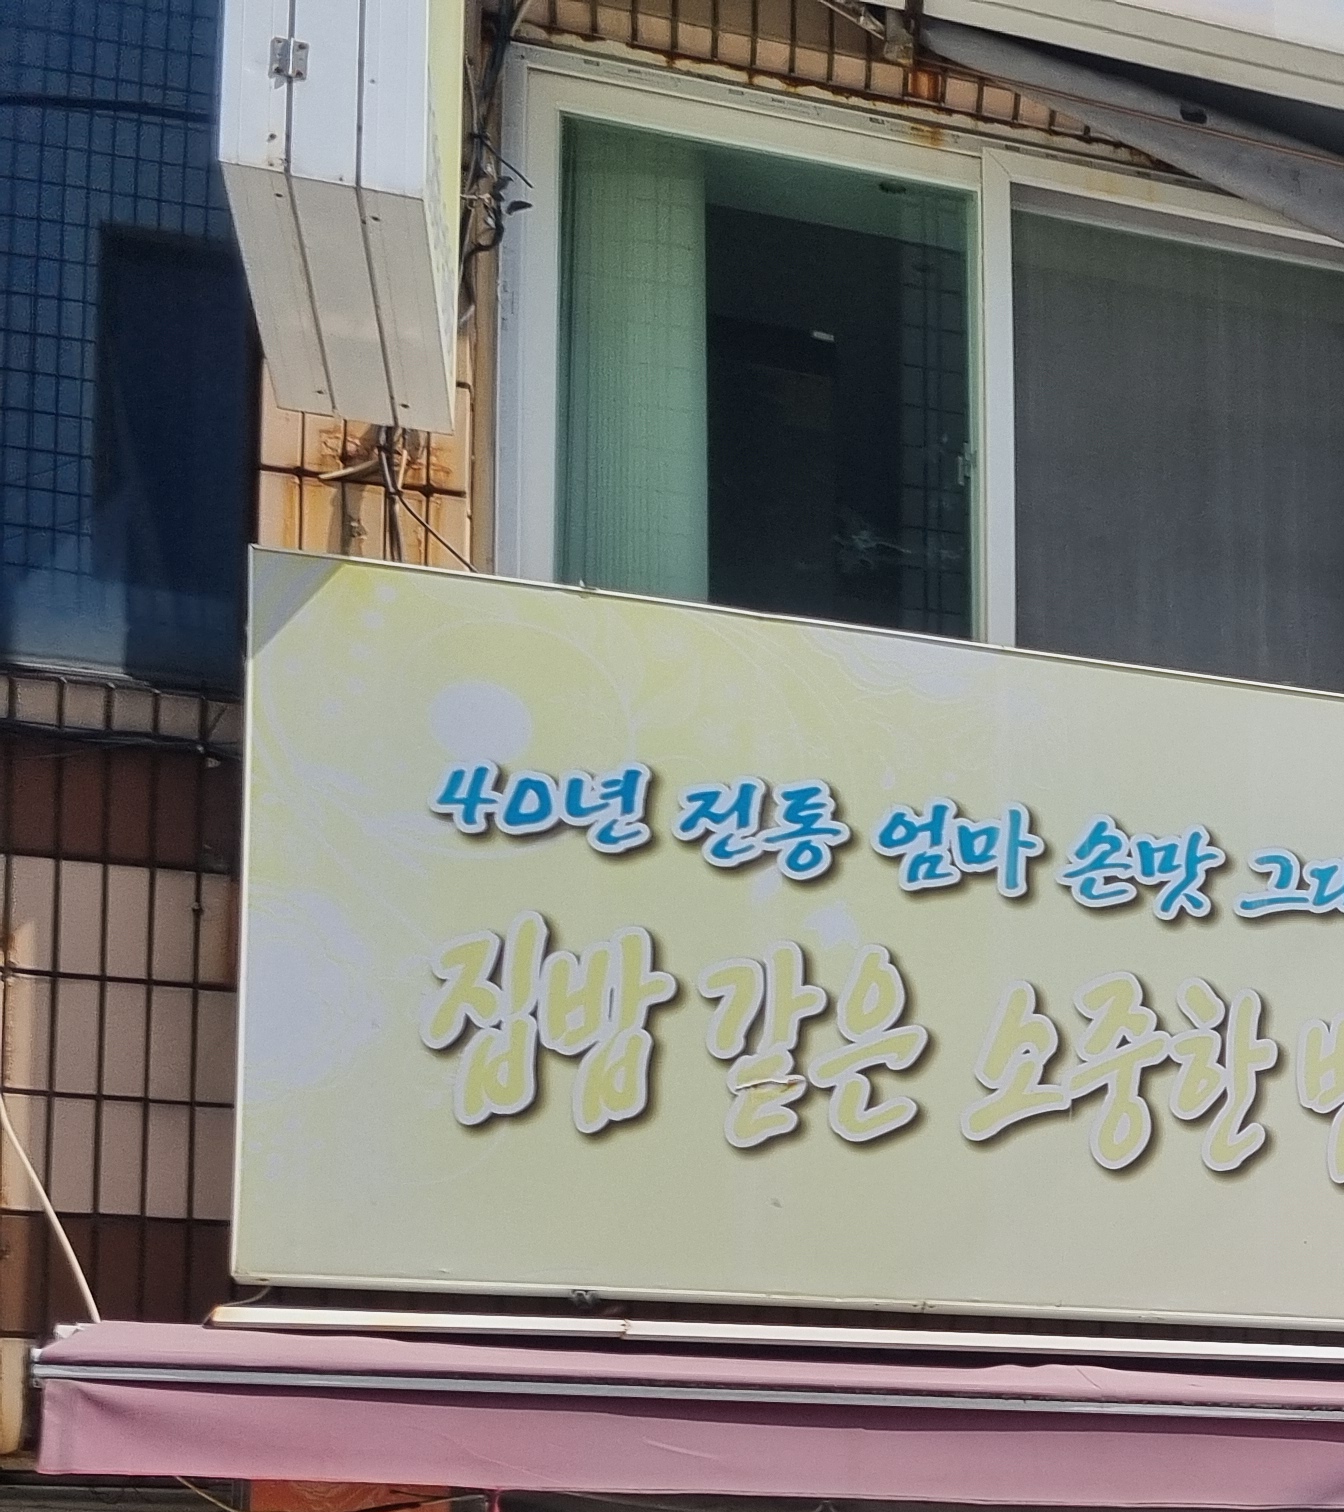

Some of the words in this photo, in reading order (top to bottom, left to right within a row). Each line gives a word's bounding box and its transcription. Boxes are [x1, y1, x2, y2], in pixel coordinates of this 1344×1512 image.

[430, 760, 652, 852] 40년
[673, 776, 850, 879] 전통
[873, 800, 1043, 898] 엄마
[1056, 815, 1225, 920] 손맛
[419, 912, 680, 1132] 집밥
[698, 940, 927, 1147] 같은
[958, 968, 1278, 1171] 소중한
